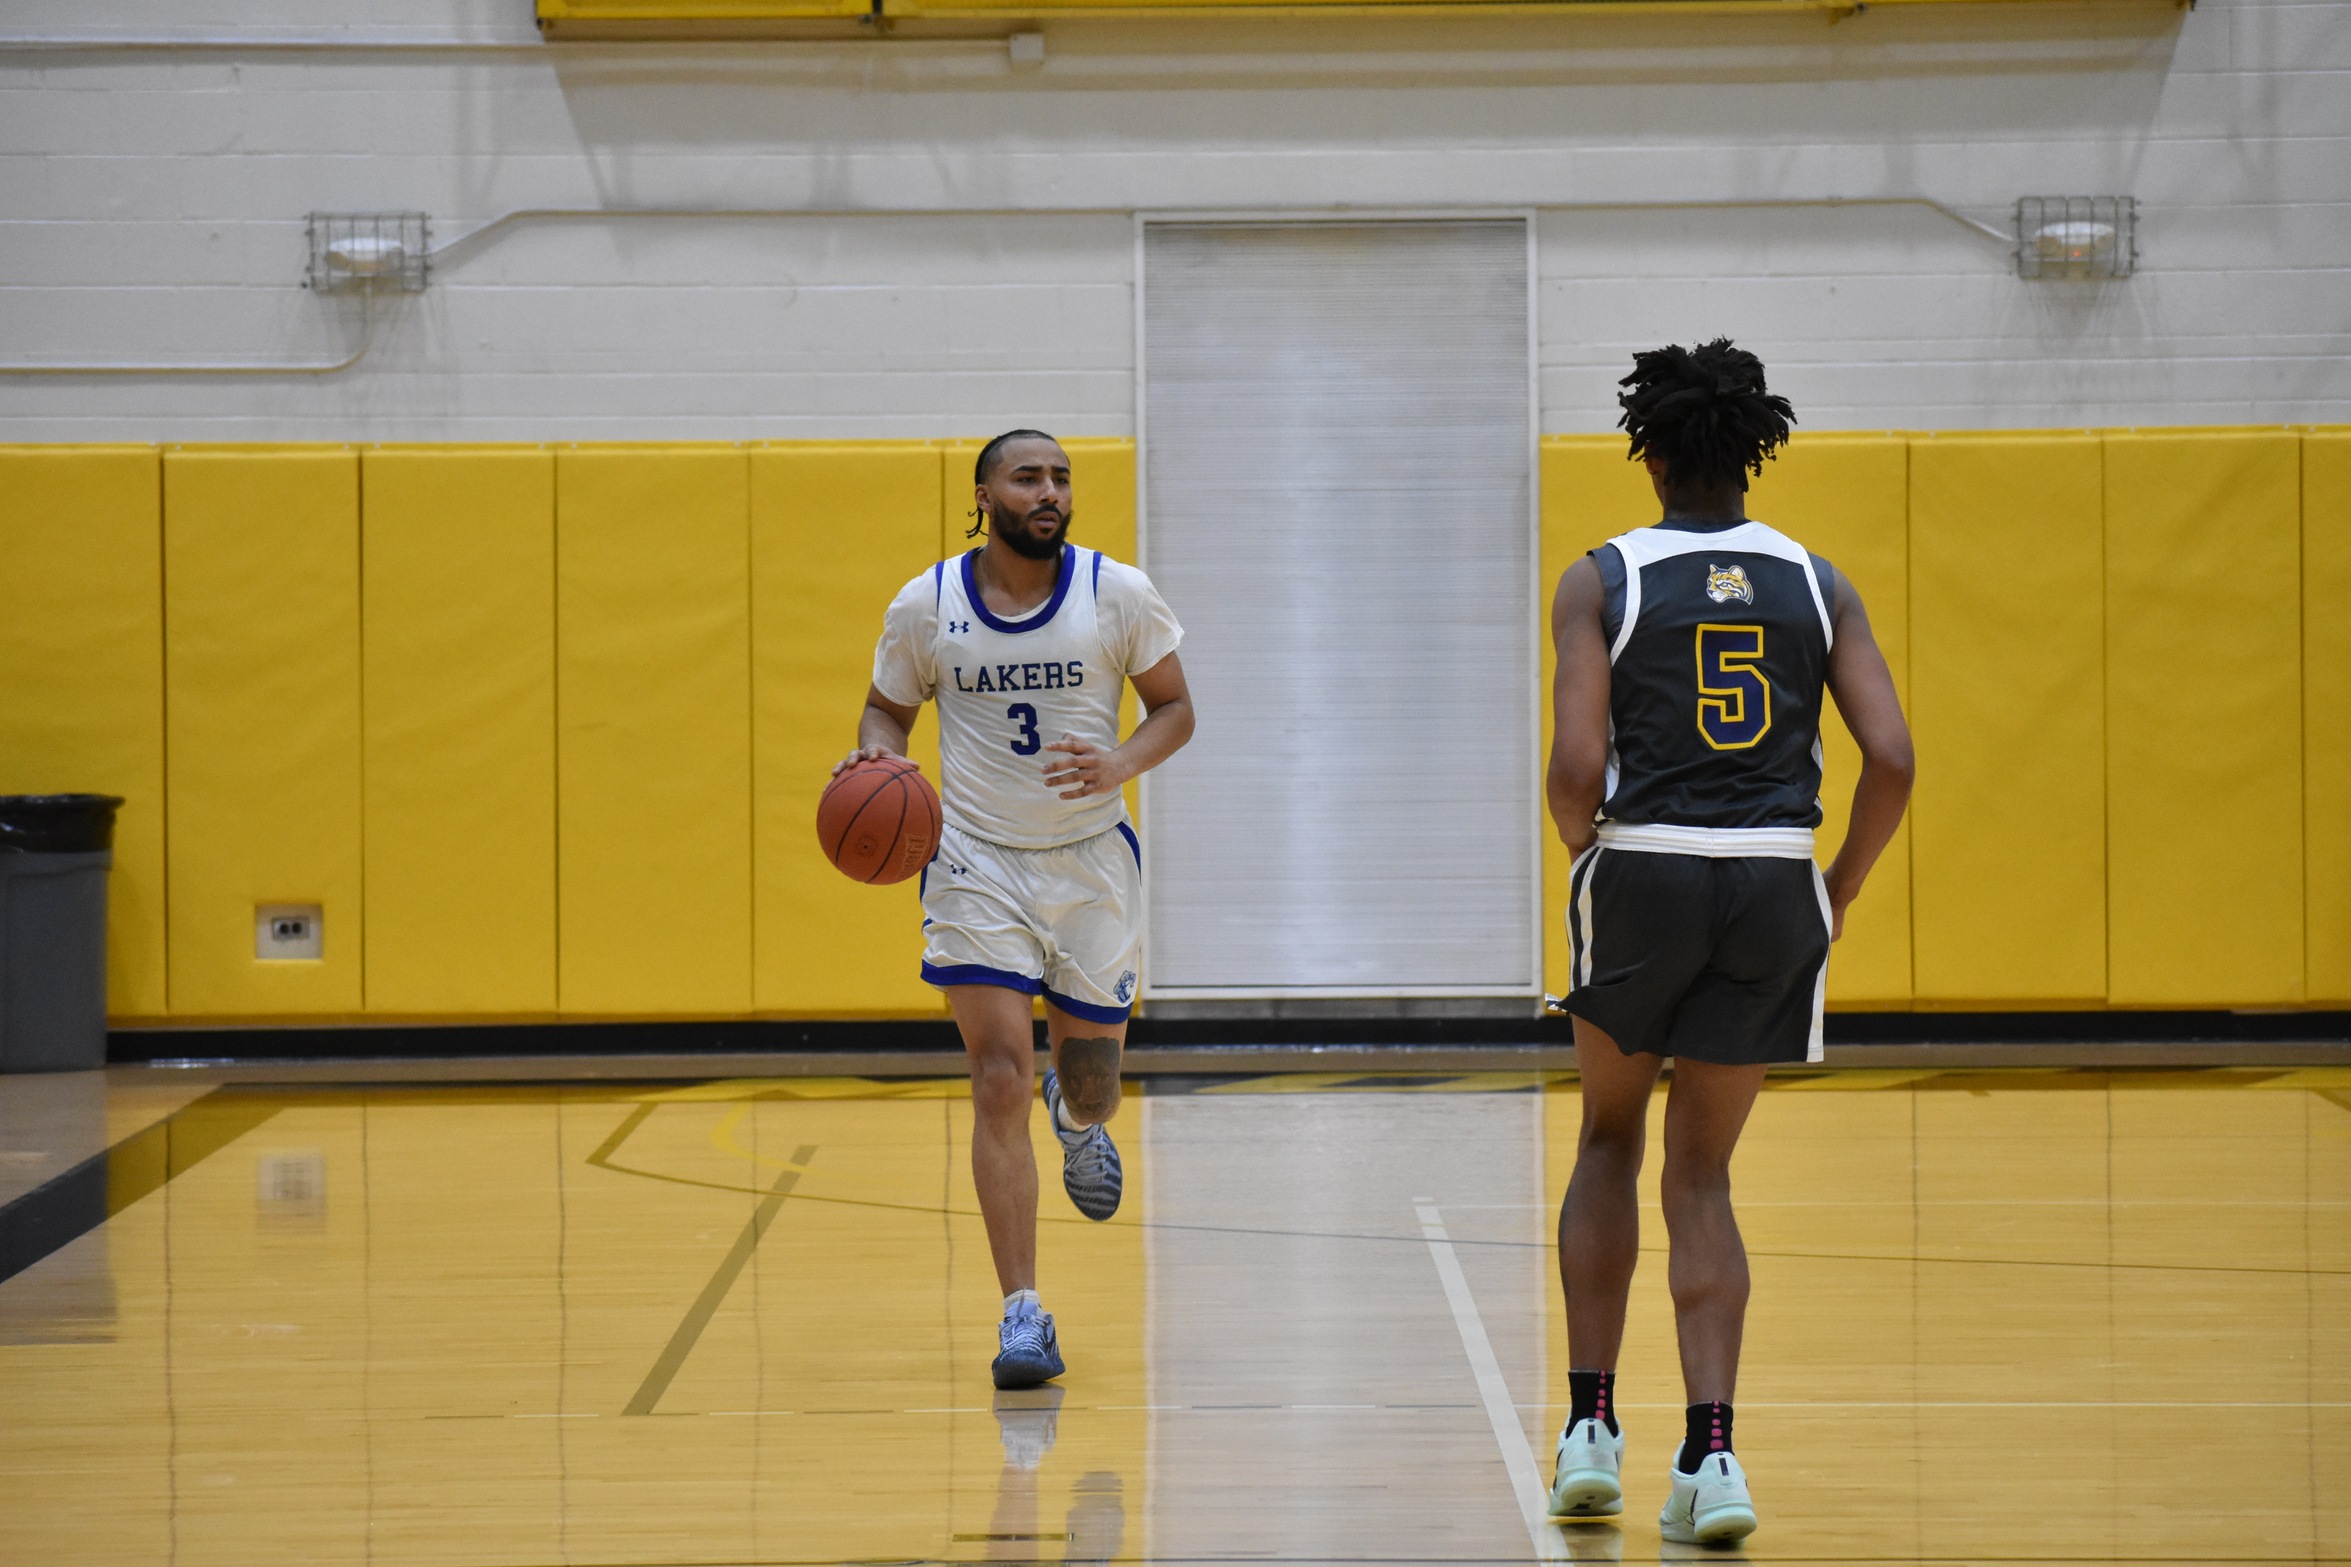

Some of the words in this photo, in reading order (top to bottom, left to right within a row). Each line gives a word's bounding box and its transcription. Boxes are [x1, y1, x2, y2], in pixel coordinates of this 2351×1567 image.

[954, 660, 1084, 693] LAKERS
[1695, 623, 1772, 751] 5
[1007, 702, 1042, 756] 3
